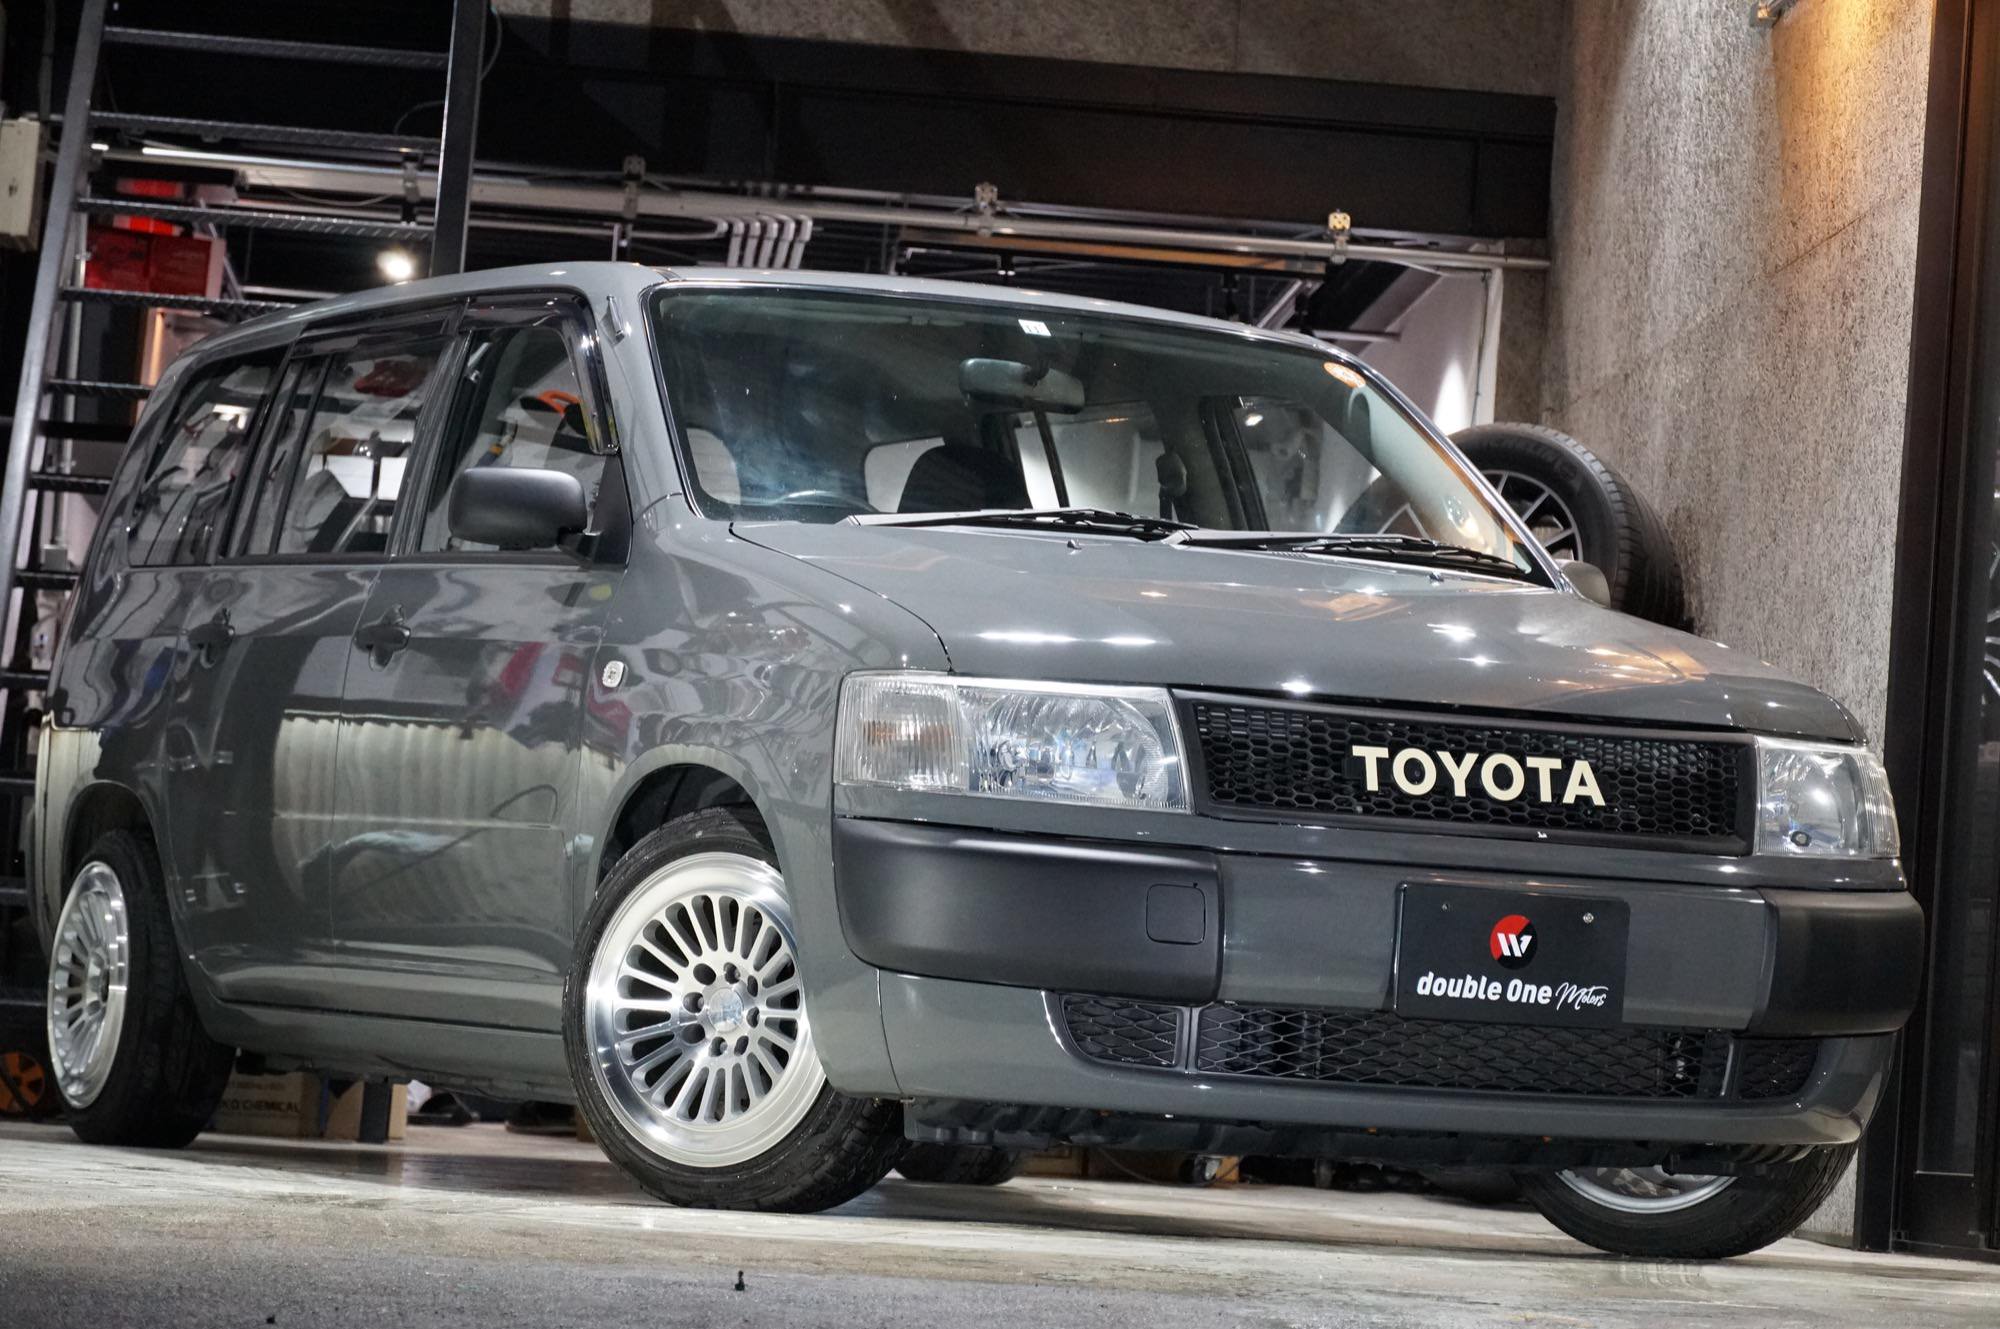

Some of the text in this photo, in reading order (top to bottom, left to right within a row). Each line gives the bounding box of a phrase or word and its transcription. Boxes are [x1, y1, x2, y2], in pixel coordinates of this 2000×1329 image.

[1352, 745, 1606, 806] TOYOTA
[1416, 971, 1609, 1011] double One Motors
[242, 1099, 301, 1113] CHEMICAL
